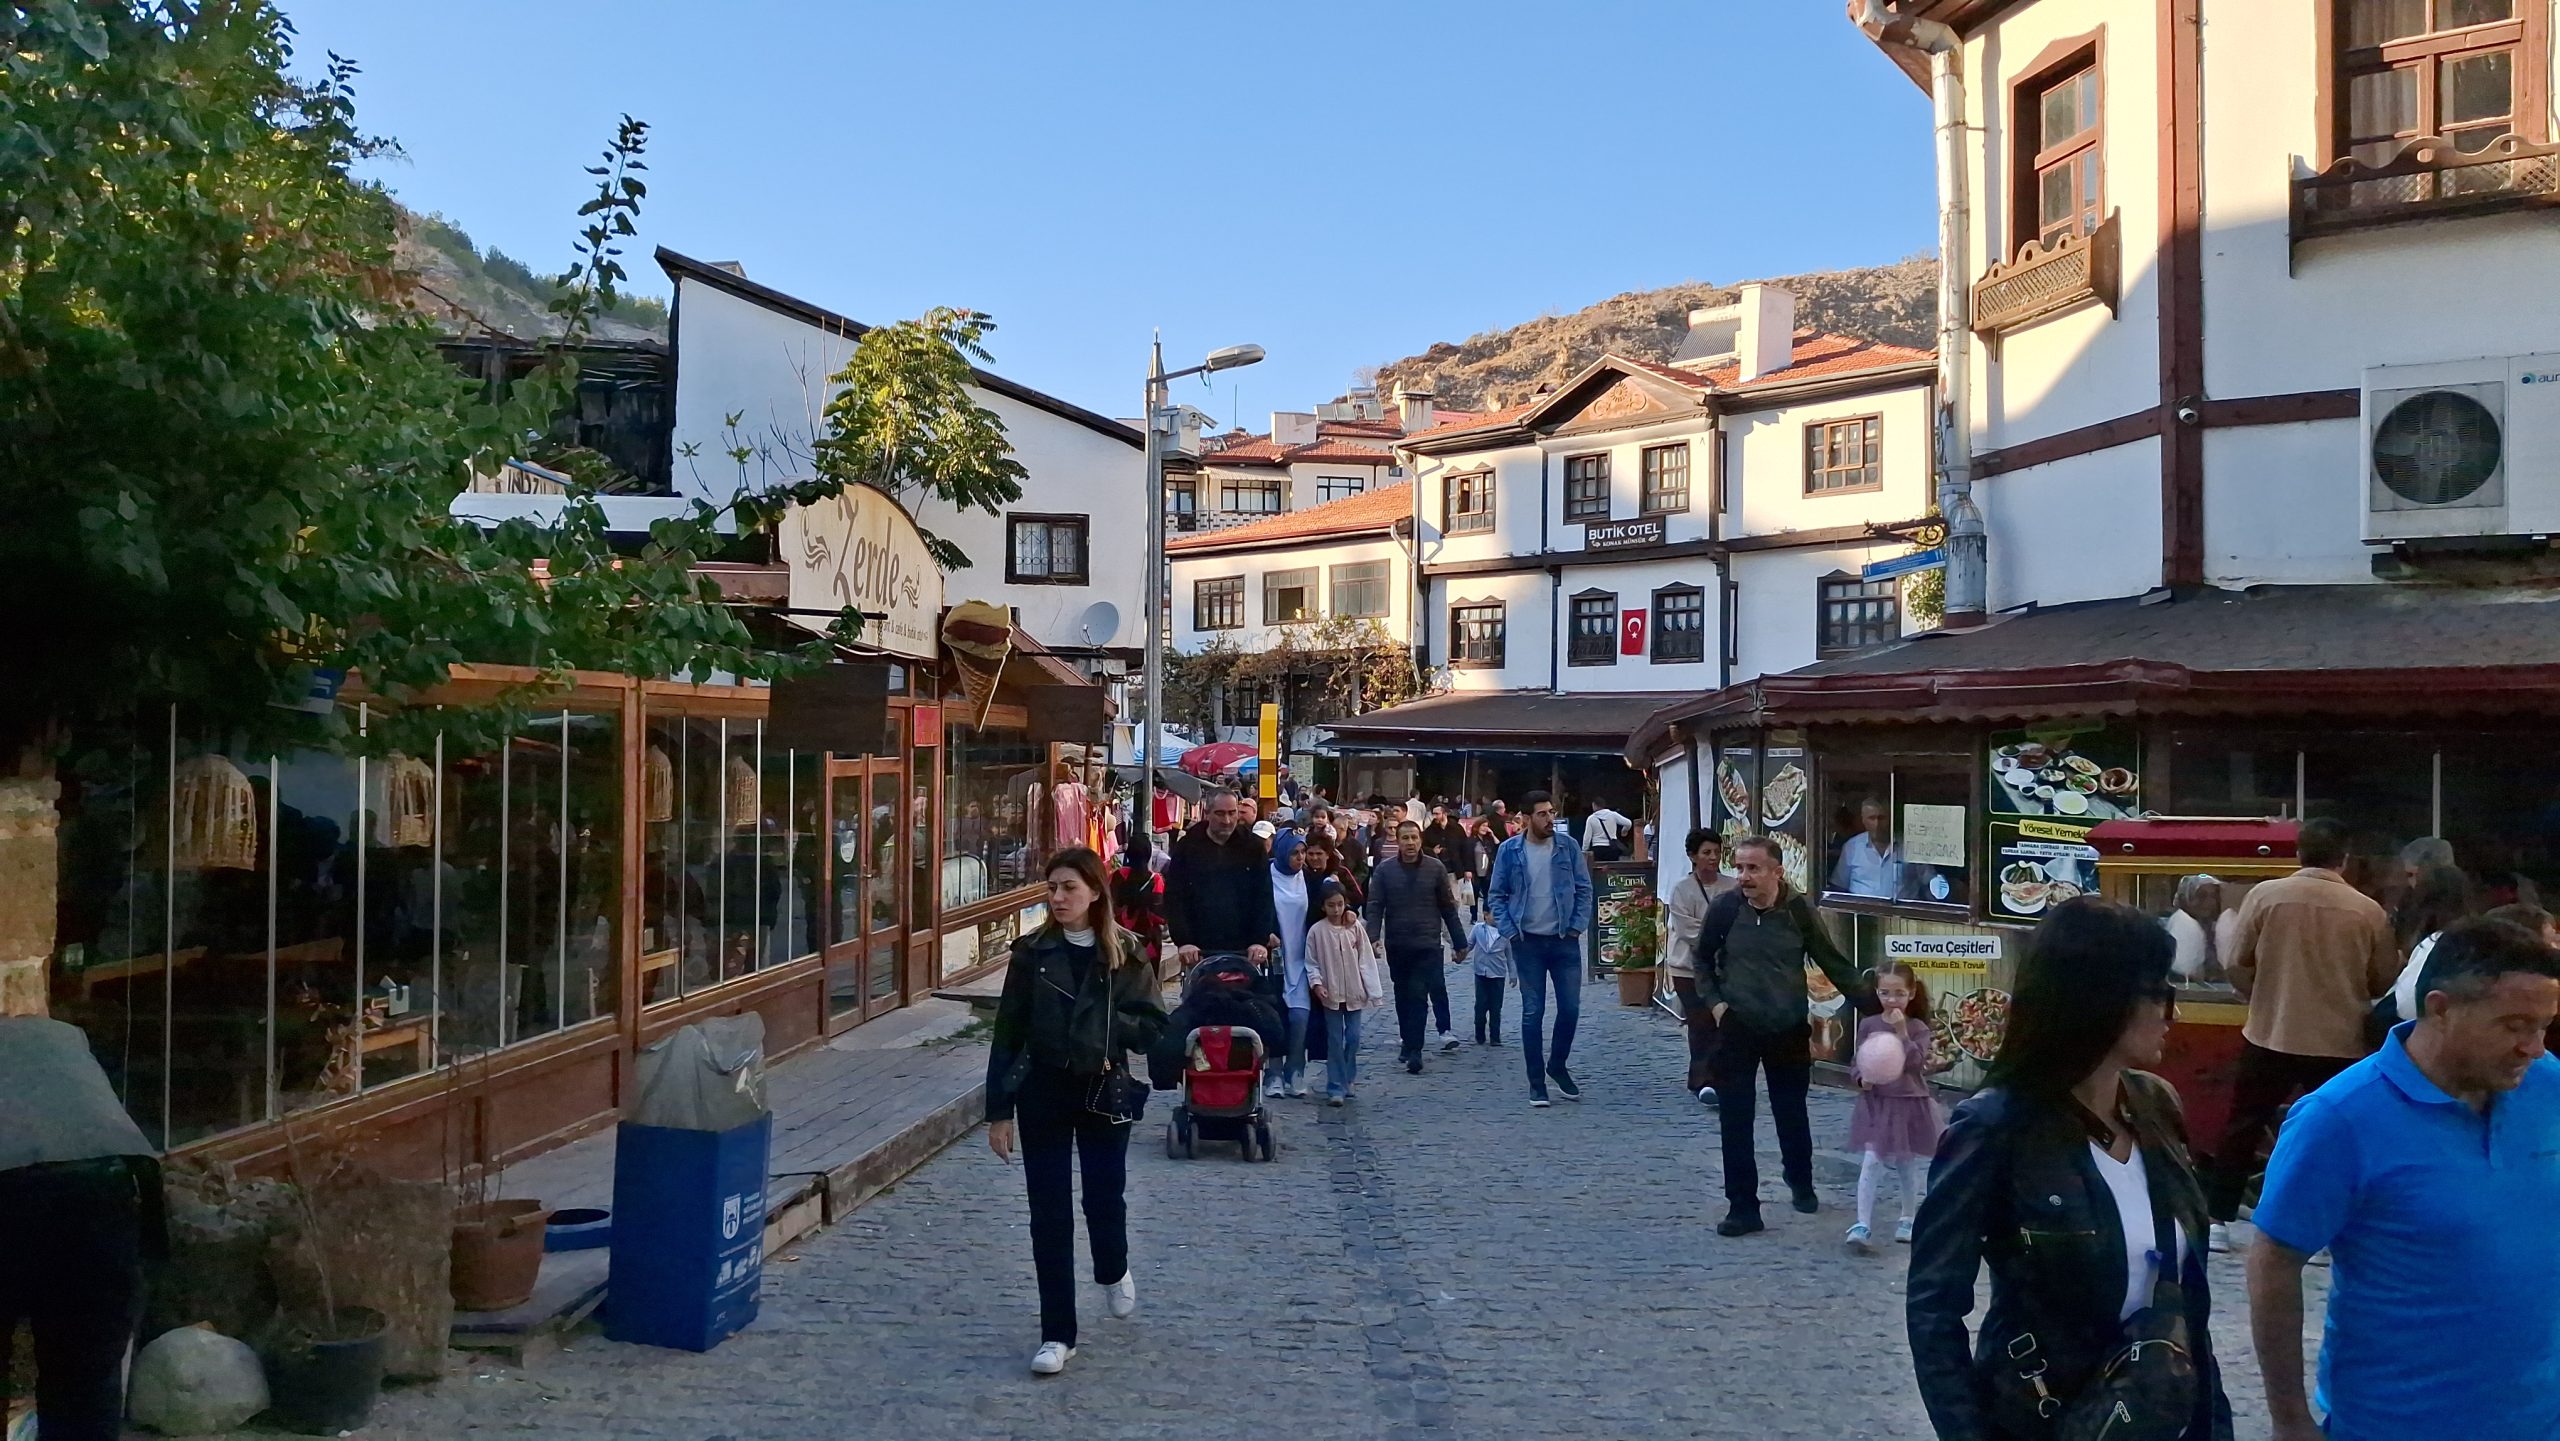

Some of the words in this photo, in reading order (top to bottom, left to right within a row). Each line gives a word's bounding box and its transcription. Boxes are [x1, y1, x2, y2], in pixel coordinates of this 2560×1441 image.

[1589, 525, 1625, 540] BUTİK
[1628, 523, 1661, 536] OTEL
[833, 494, 900, 609] Zerde
[2023, 823, 2053, 835] Yöresel
[1891, 940, 1912, 953] Sac
[1914, 940, 1943, 953] Tava
[1945, 940, 1995, 957] Çeşitleri
[1930, 961, 1949, 969] Kuzu
[1962, 961, 1985, 969] Tavuk
